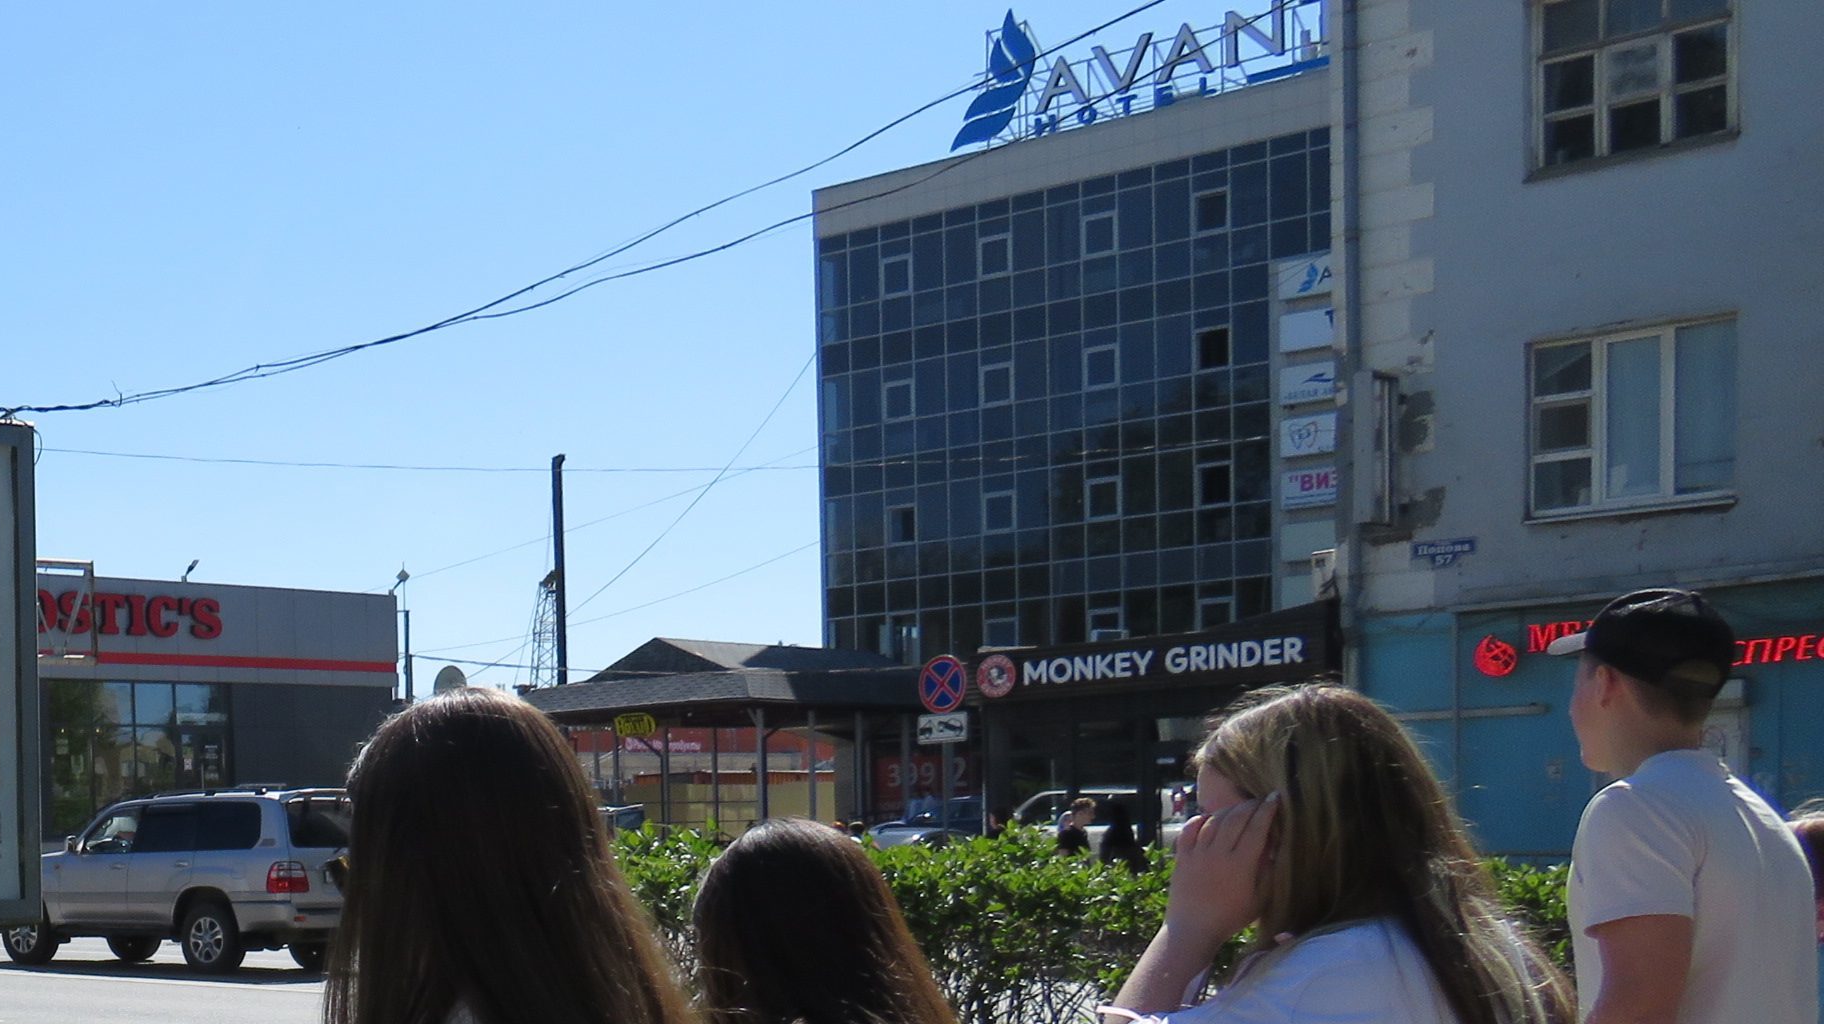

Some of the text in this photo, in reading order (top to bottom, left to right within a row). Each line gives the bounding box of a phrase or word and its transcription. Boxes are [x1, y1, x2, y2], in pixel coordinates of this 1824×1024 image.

[1034, 0, 1329, 115] AVAN
[1033, 77, 1218, 137] HOTEL
[1023, 650, 1154, 686] MONKEY
[1164, 636, 1304, 674] GRINDER
